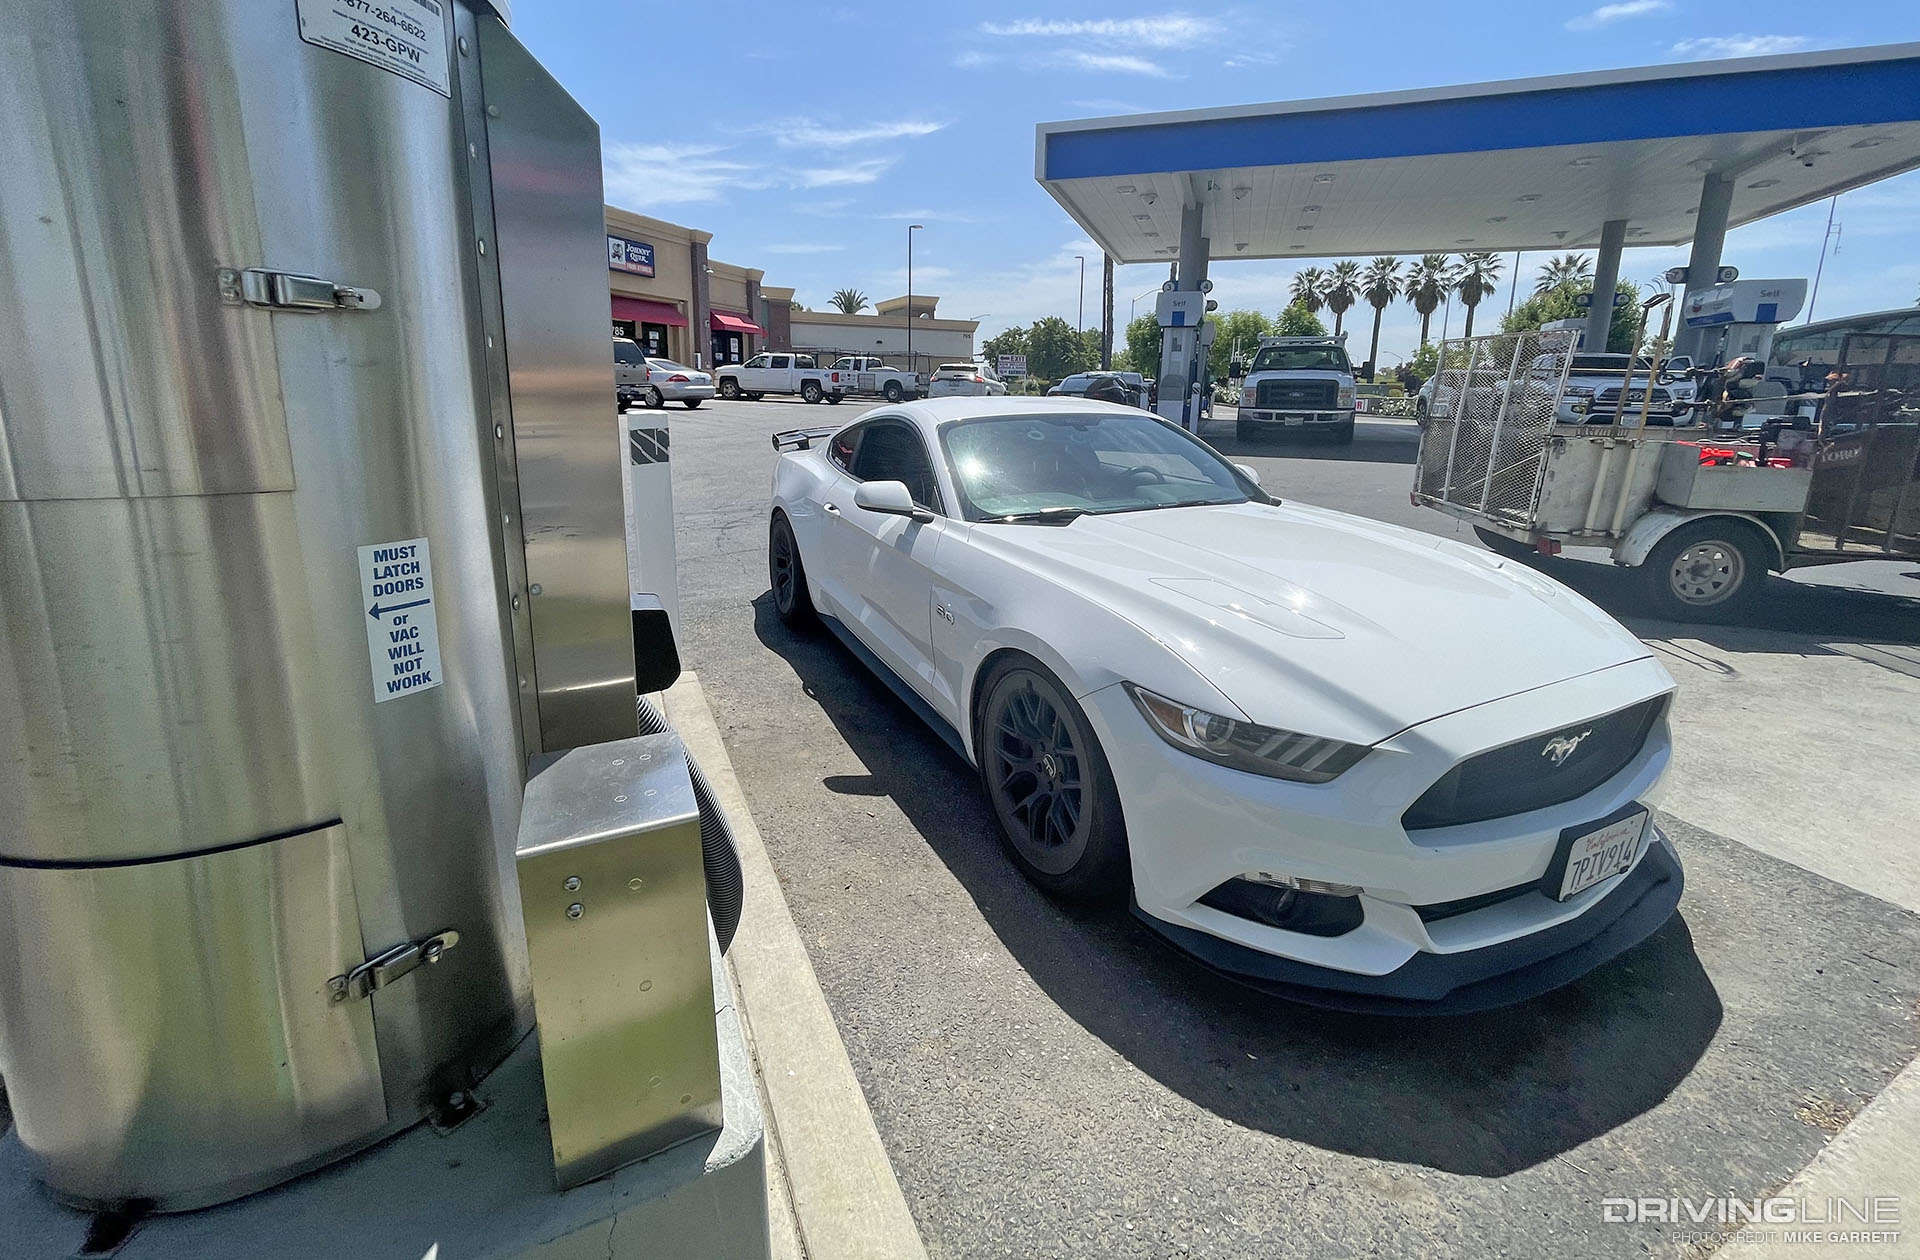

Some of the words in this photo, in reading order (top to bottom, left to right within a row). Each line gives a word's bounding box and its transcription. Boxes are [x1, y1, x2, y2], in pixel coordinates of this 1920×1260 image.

[336, 0, 427, 41] -877-264-6622
[351, 24, 420, 63] 423-GPW
[1724, 270, 1732, 279] 8
[1166, 283, 1172, 291] 3
[373, 545, 417, 563] MUST
[373, 561, 420, 580] LATCH
[373, 577, 424, 597] DOORS
[393, 614, 409, 626] or
[389, 626, 419, 643] VAC
[387, 642, 424, 660] WILL
[393, 657, 423, 676] NOT
[386, 671, 432, 693] WORK
